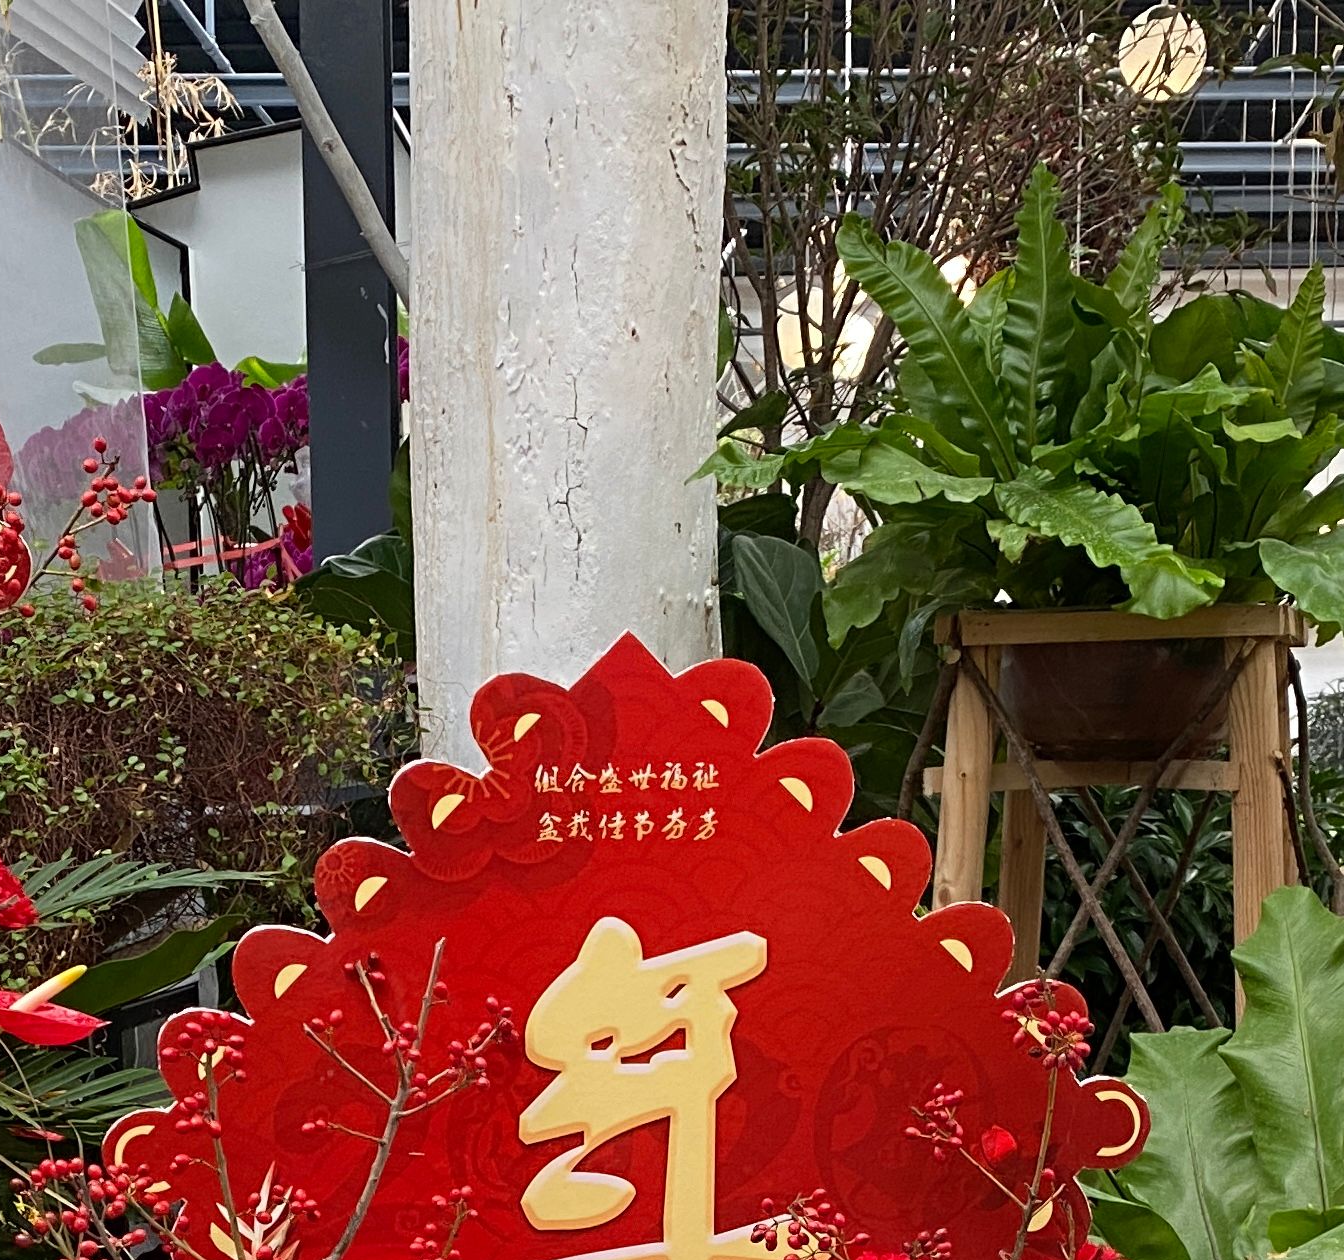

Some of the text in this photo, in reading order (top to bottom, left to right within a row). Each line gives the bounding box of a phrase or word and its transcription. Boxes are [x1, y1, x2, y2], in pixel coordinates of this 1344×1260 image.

[534, 761, 720, 793] 组合盛世福祉
[536, 806, 718, 842] 盆栽佳节芬芳
